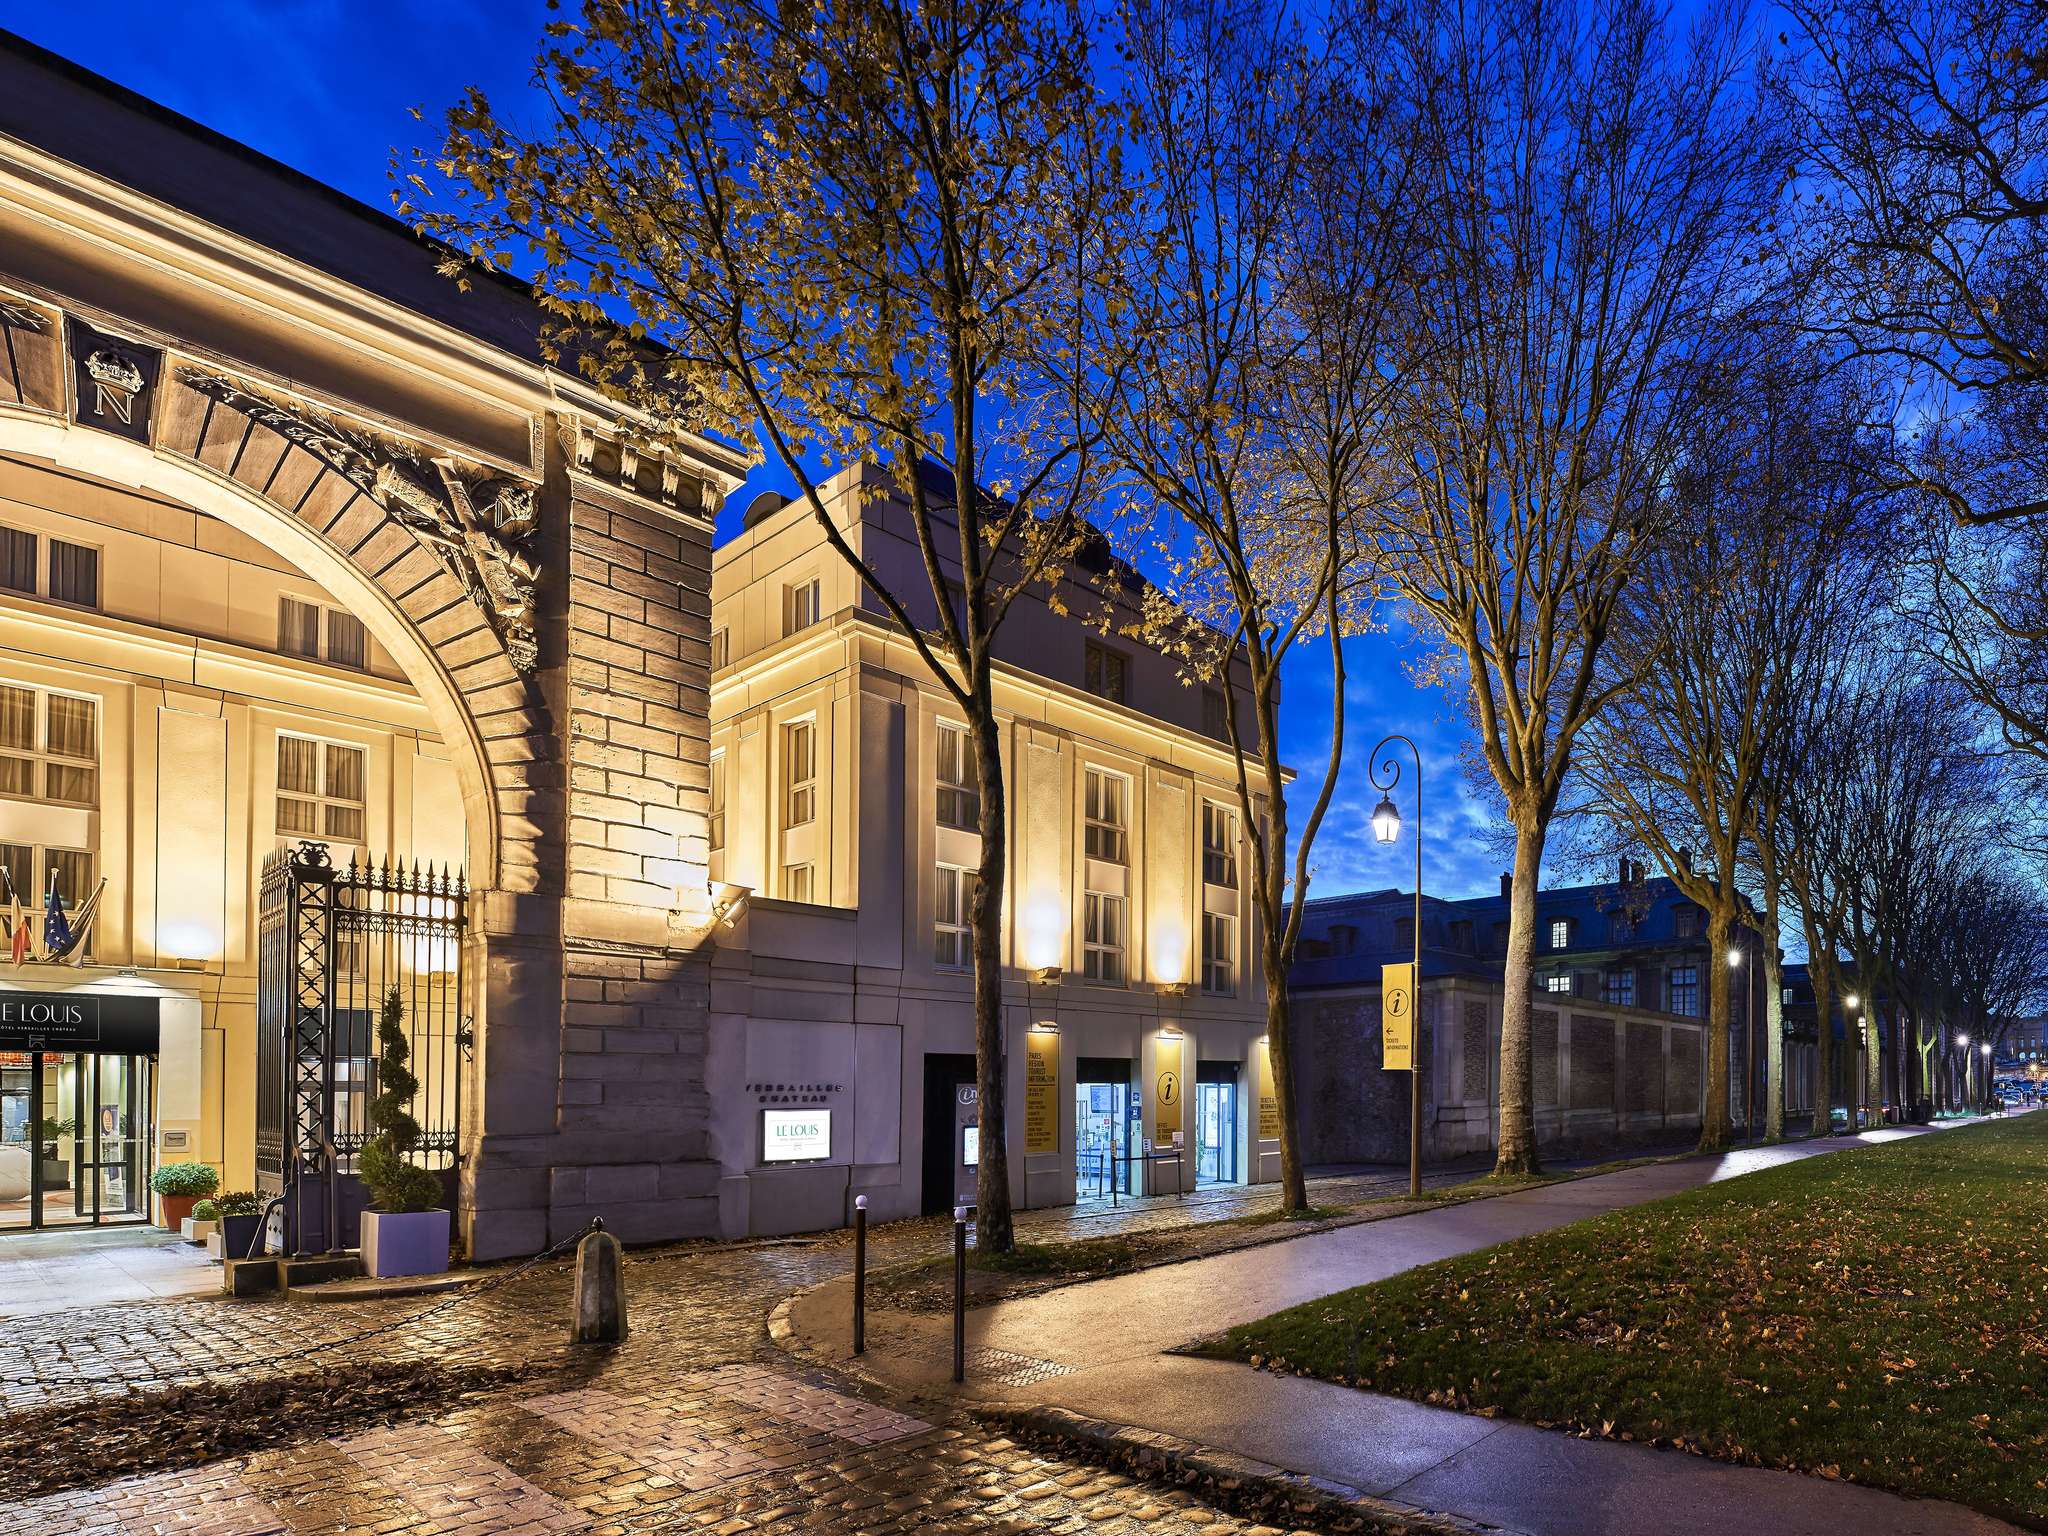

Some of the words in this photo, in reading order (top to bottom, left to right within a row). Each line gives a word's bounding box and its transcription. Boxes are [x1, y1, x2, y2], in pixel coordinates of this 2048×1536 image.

[94, 382, 134, 424] N
[1, 1002, 15, 1022] E
[21, 1003, 82, 1024] LOUIS
[1029, 1052, 1041, 1060] PARIS
[776, 1125, 788, 1137] LE
[790, 1124, 819, 1136] LOUIS
